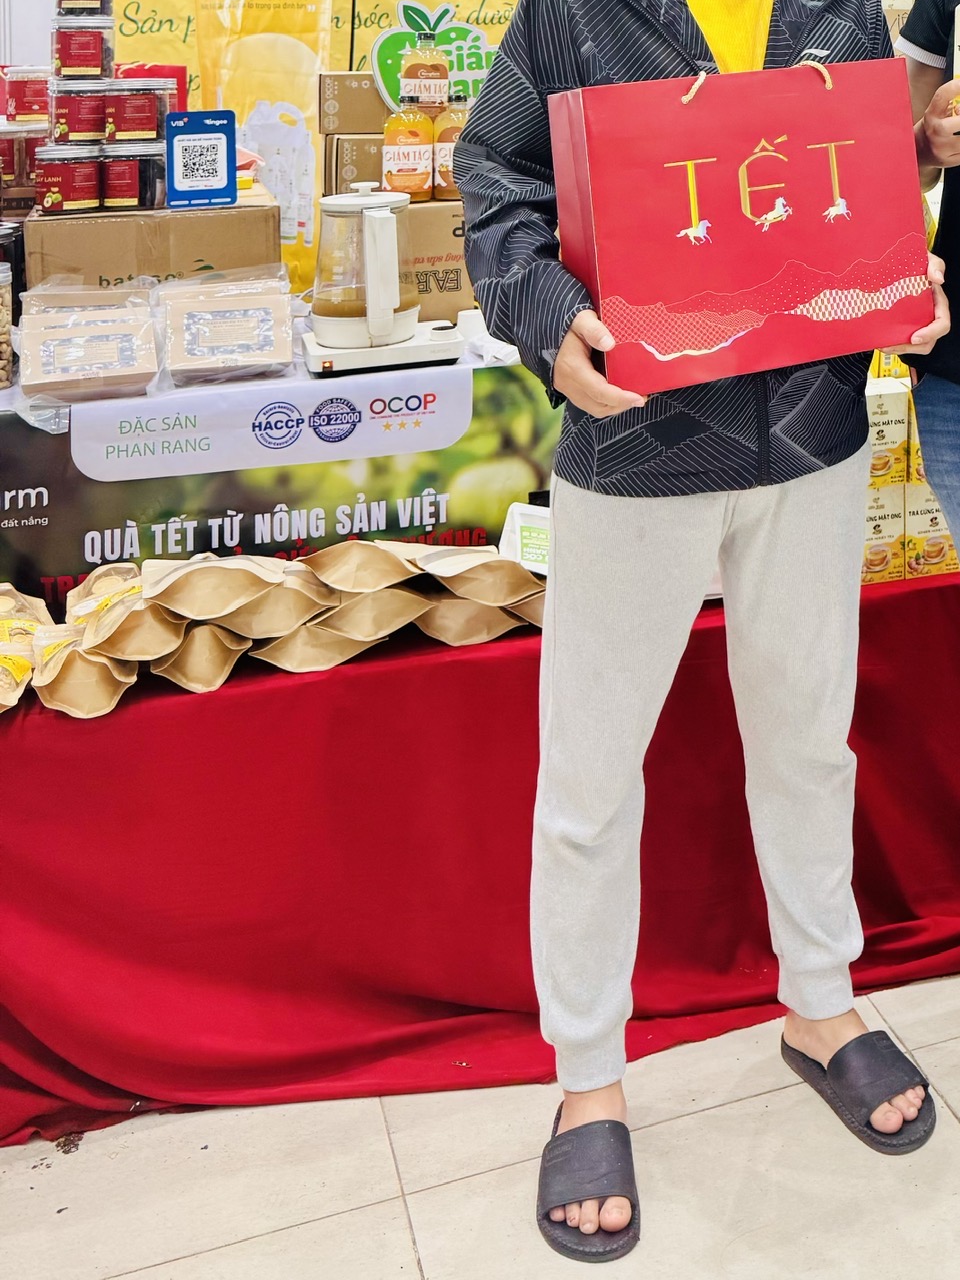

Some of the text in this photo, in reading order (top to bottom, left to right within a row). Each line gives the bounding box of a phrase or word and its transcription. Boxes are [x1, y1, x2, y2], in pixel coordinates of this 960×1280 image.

[119, 1, 180, 38] Sản
[353, 4, 393, 29] sóc,
[664, 135, 854, 230] TẾT
[402, 268, 462, 295] FAR
[369, 393, 437, 415] OCOP
[118, 412, 197, 436] ĐẶC SẢN
[252, 417, 305, 433] HACCP
[310, 415, 328, 427] ISO
[330, 412, 360, 425] 22000
[105, 436, 211, 459] PHAN RANG
[1, 517, 19, 528] đất
[84, 519, 140, 565] QUÀ
[151, 514, 197, 555] TẾT
[208, 510, 244, 549] TỪ
[254, 504, 326, 544] NÔNG
[335, 492, 386, 535] SẢN
[397, 488, 450, 531] VIỆT
